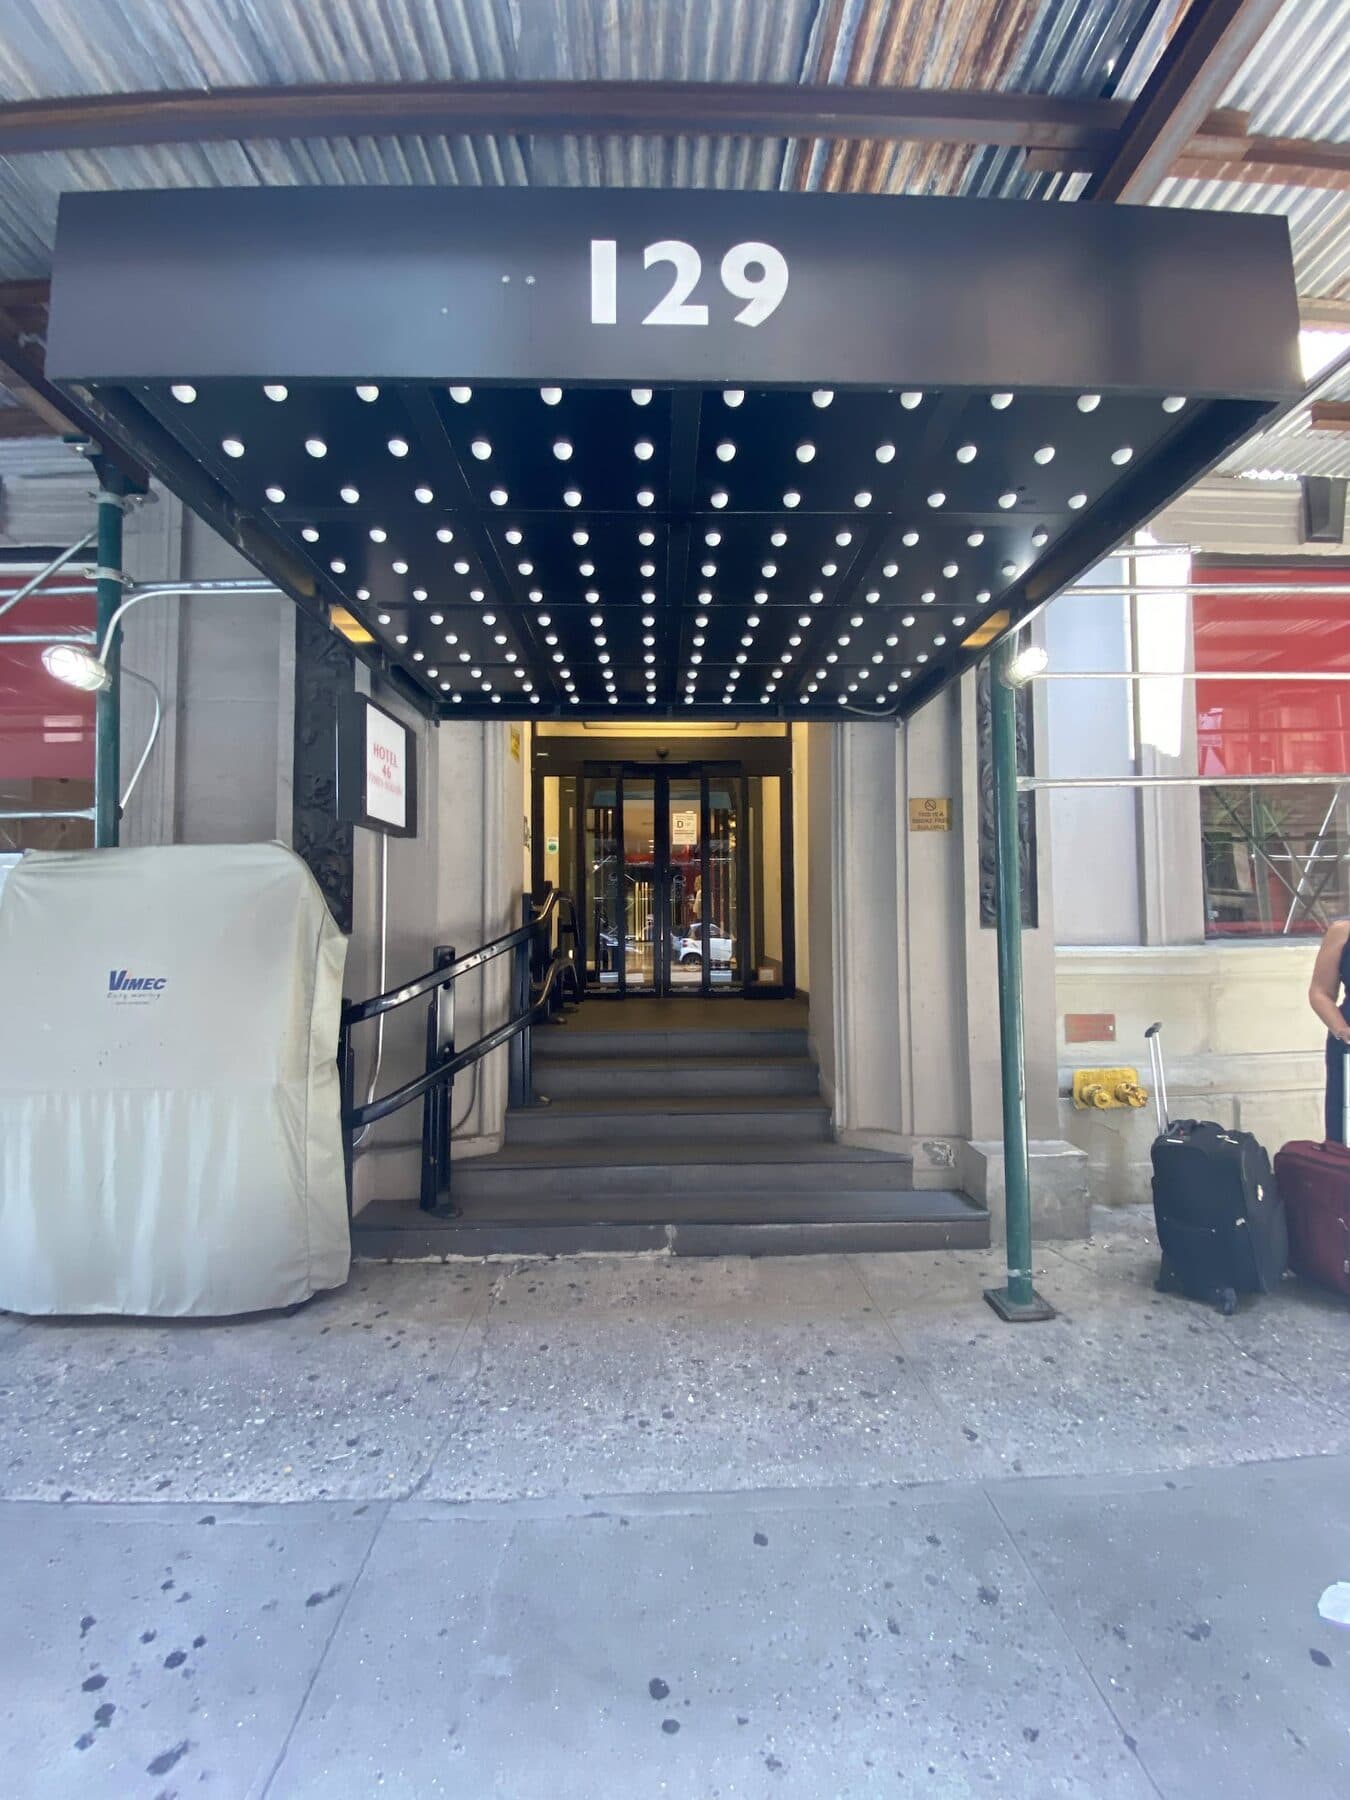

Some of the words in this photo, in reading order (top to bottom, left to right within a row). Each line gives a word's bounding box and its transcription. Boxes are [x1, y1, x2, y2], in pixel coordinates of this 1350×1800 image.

[591, 239, 789, 327] 129
[373, 743, 399, 768] HOTEL
[382, 764, 392, 780] 46
[676, 820, 684, 828] D
